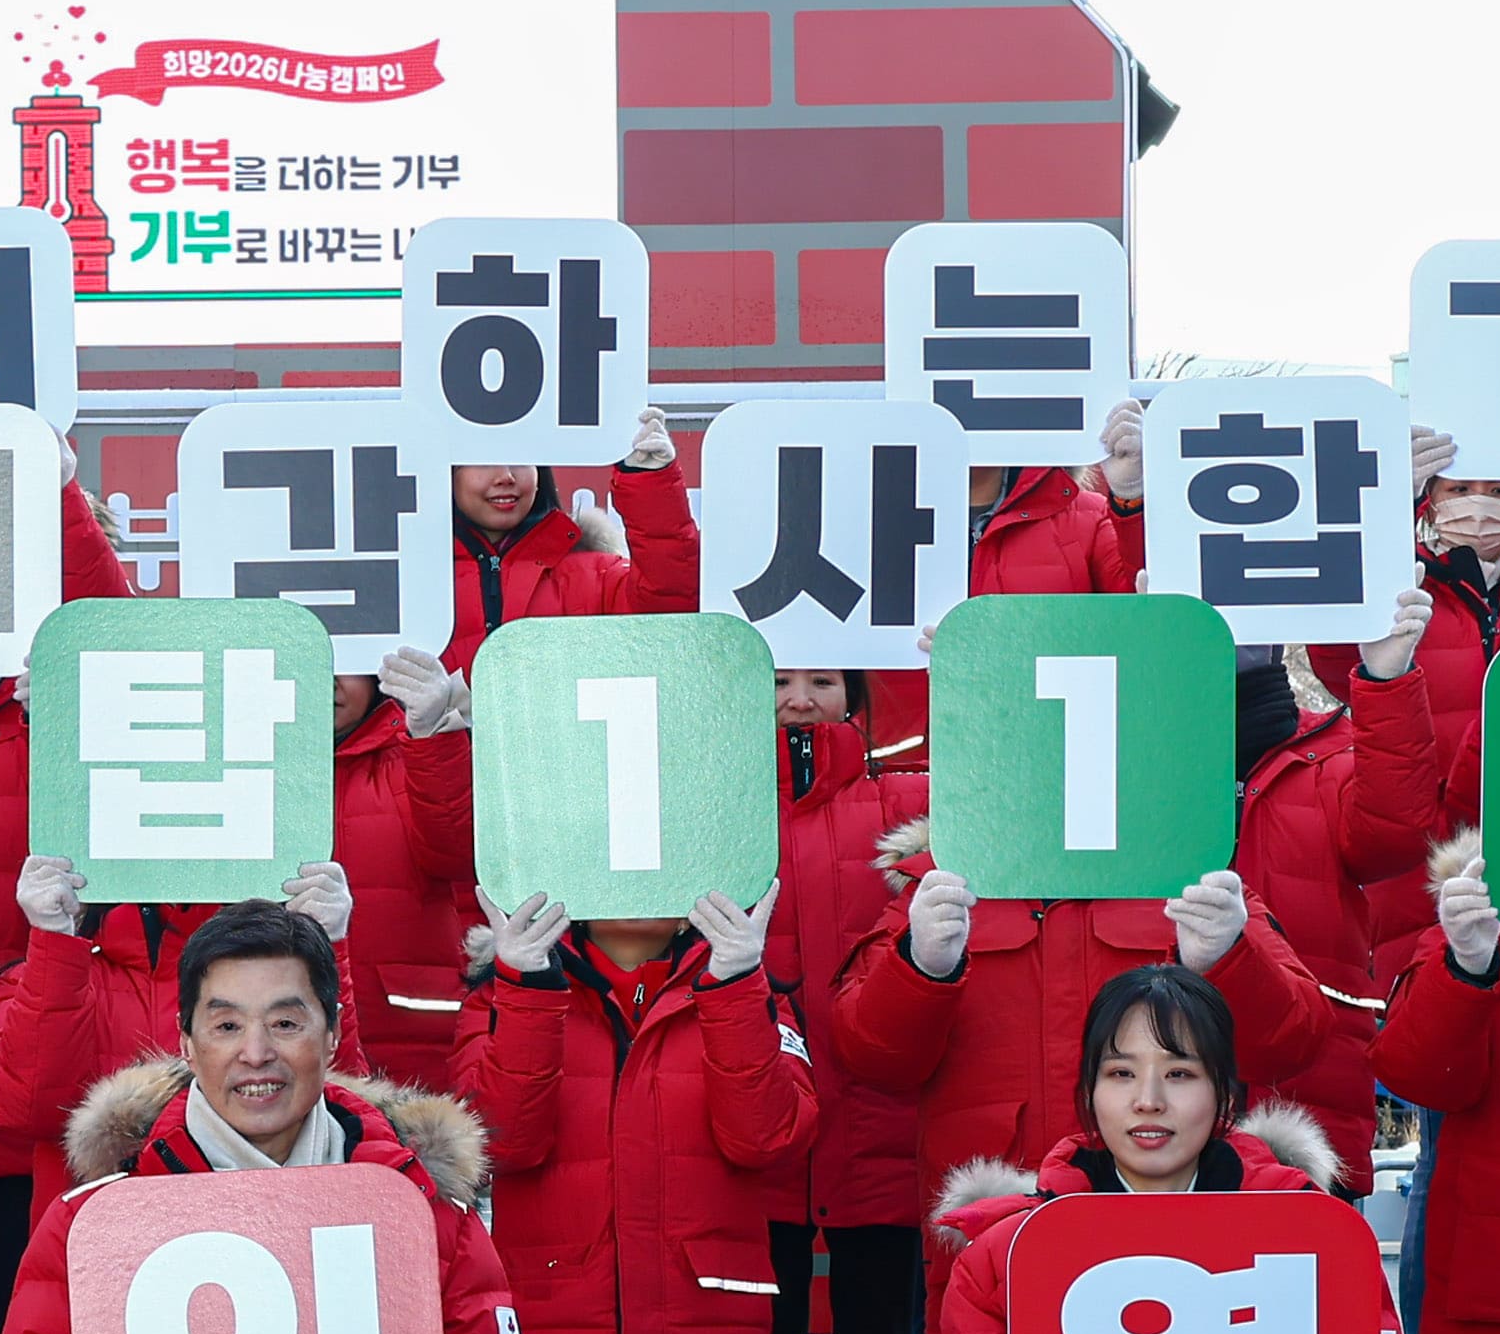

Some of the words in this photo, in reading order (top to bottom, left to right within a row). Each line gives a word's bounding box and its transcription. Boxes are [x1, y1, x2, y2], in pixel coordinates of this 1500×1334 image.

[162, 49, 407, 94] 희망2026나눔캠페인
[126, 138, 267, 194] 행복을
[278, 154, 382, 191] 더하는
[392, 154, 461, 190] 기부
[129, 210, 268, 265] 기부로
[278, 227, 382, 263] 바꾸는
[435, 255, 618, 427] 하
[923, 265, 1091, 432] 는
[222, 446, 417, 637] 감
[733, 445, 935, 627] 사
[1180, 413, 1379, 607] 합
[79, 649, 296, 860] 탑
[576, 677, 662, 872] 1
[1035, 656, 1118, 850] 1
